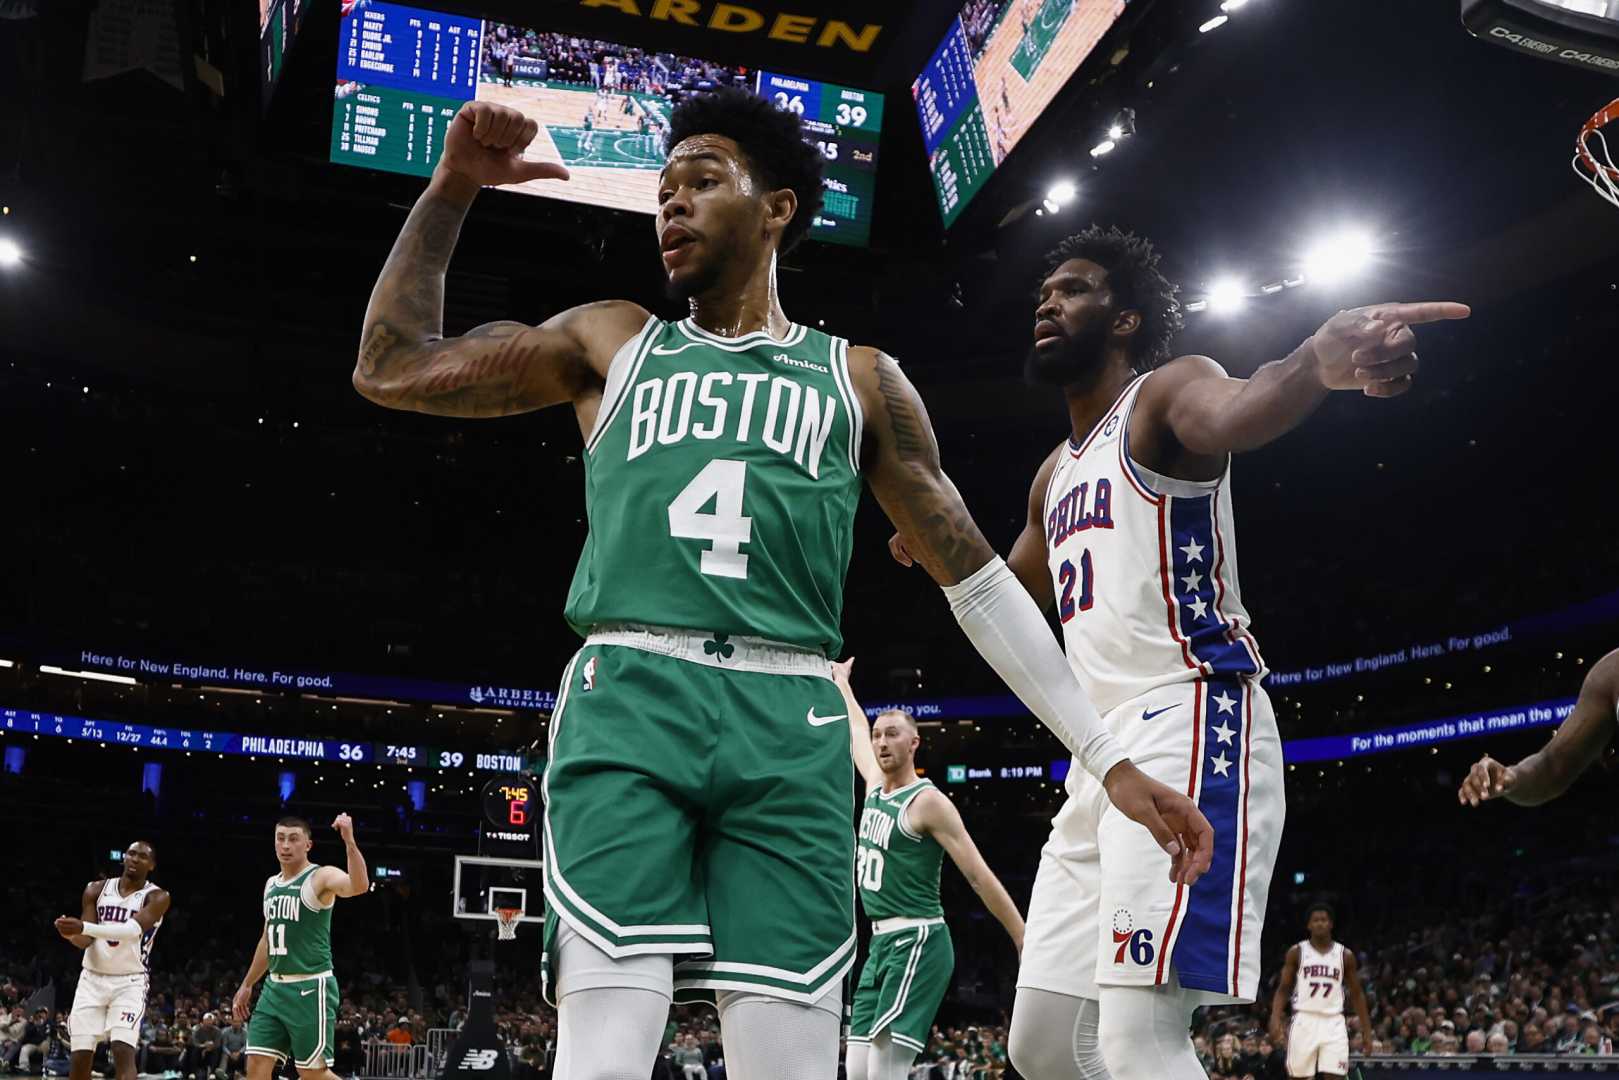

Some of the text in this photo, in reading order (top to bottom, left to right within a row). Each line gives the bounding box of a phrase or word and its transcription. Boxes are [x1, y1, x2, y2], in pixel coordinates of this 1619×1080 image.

[580, 0, 882, 52] ARDEN
[1490, 27, 1522, 43] C4
[1560, 50, 1619, 69] C4 ENERG
[514, 65, 541, 74] IMCO
[774, 92, 805, 115] 36
[836, 104, 867, 127] 39
[853, 150, 872, 161] 2nd
[773, 354, 828, 373] Amica
[627, 372, 836, 480] BOSTON
[668, 459, 752, 579] 4
[1048, 478, 1114, 548] PHILA
[1059, 548, 1094, 624] 21
[1270, 627, 1512, 685] Here for New England. Here. For good.
[81, 651, 333, 688] Here for New England. Here. For good.
[484, 686, 554, 702] ARBELL
[917, 705, 942, 716] you.
[55, 724, 62, 733] 6
[81, 727, 102, 738] 5/13
[116, 731, 141, 742] 12/27
[205, 740, 211, 749] 2
[1352, 737, 1371, 751] For
[1375, 733, 1394, 747] the
[1398, 724, 1456, 744] moments
[1458, 718, 1485, 733] that
[1488, 712, 1526, 728] mean
[1529, 707, 1552, 722] the
[242, 737, 324, 757] PHILADELPHIA
[339, 744, 363, 760] 36
[386, 745, 416, 759] 7:45
[440, 752, 463, 767] 39
[476, 754, 521, 771] BOSTON
[968, 768, 992, 778] Bank
[1001, 767, 1043, 778] 8:19 PM
[501, 786, 528, 801] 7:45
[510, 801, 525, 824] 6
[498, 833, 530, 841] TISSOT
[859, 808, 895, 850] STON
[264, 895, 300, 921] OSTON
[268, 924, 287, 955] 11
[1112, 928, 1154, 966] 76
[1304, 964, 1340, 980] PHILA
[1310, 983, 1333, 998] 77
[121, 1012, 135, 1023] 76
